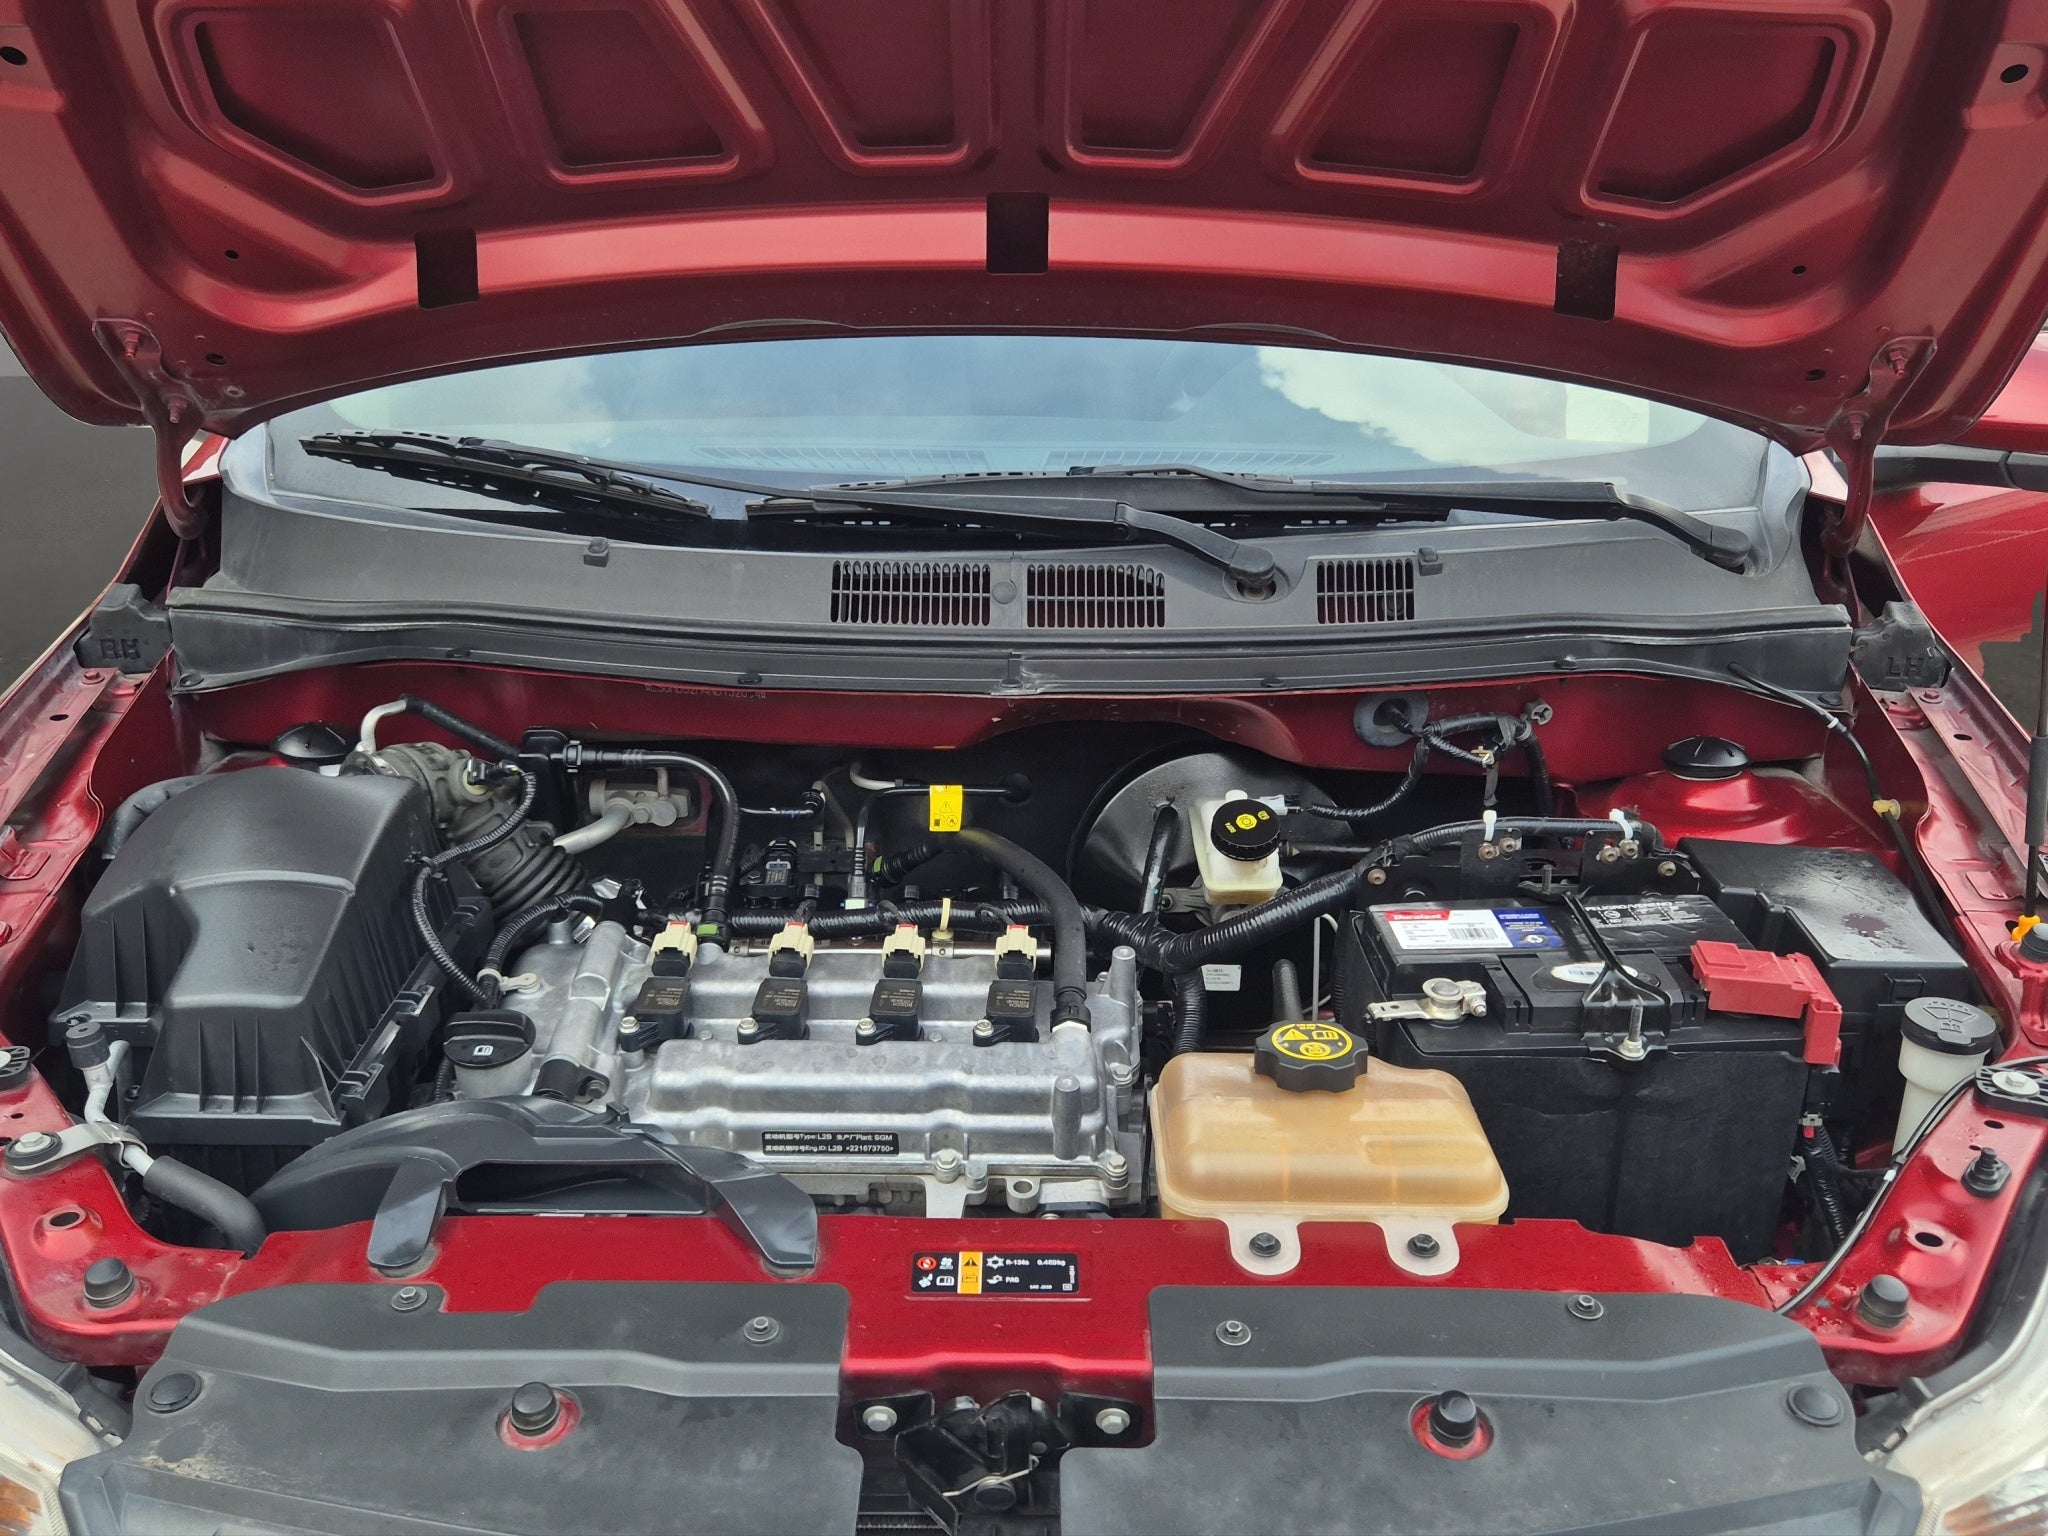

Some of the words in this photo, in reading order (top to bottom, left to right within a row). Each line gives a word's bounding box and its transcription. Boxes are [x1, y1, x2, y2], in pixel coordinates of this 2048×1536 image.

[101, 638, 140, 660] RH
[1888, 656, 1924, 678] LH
[1392, 913, 1442, 921] Duralast
